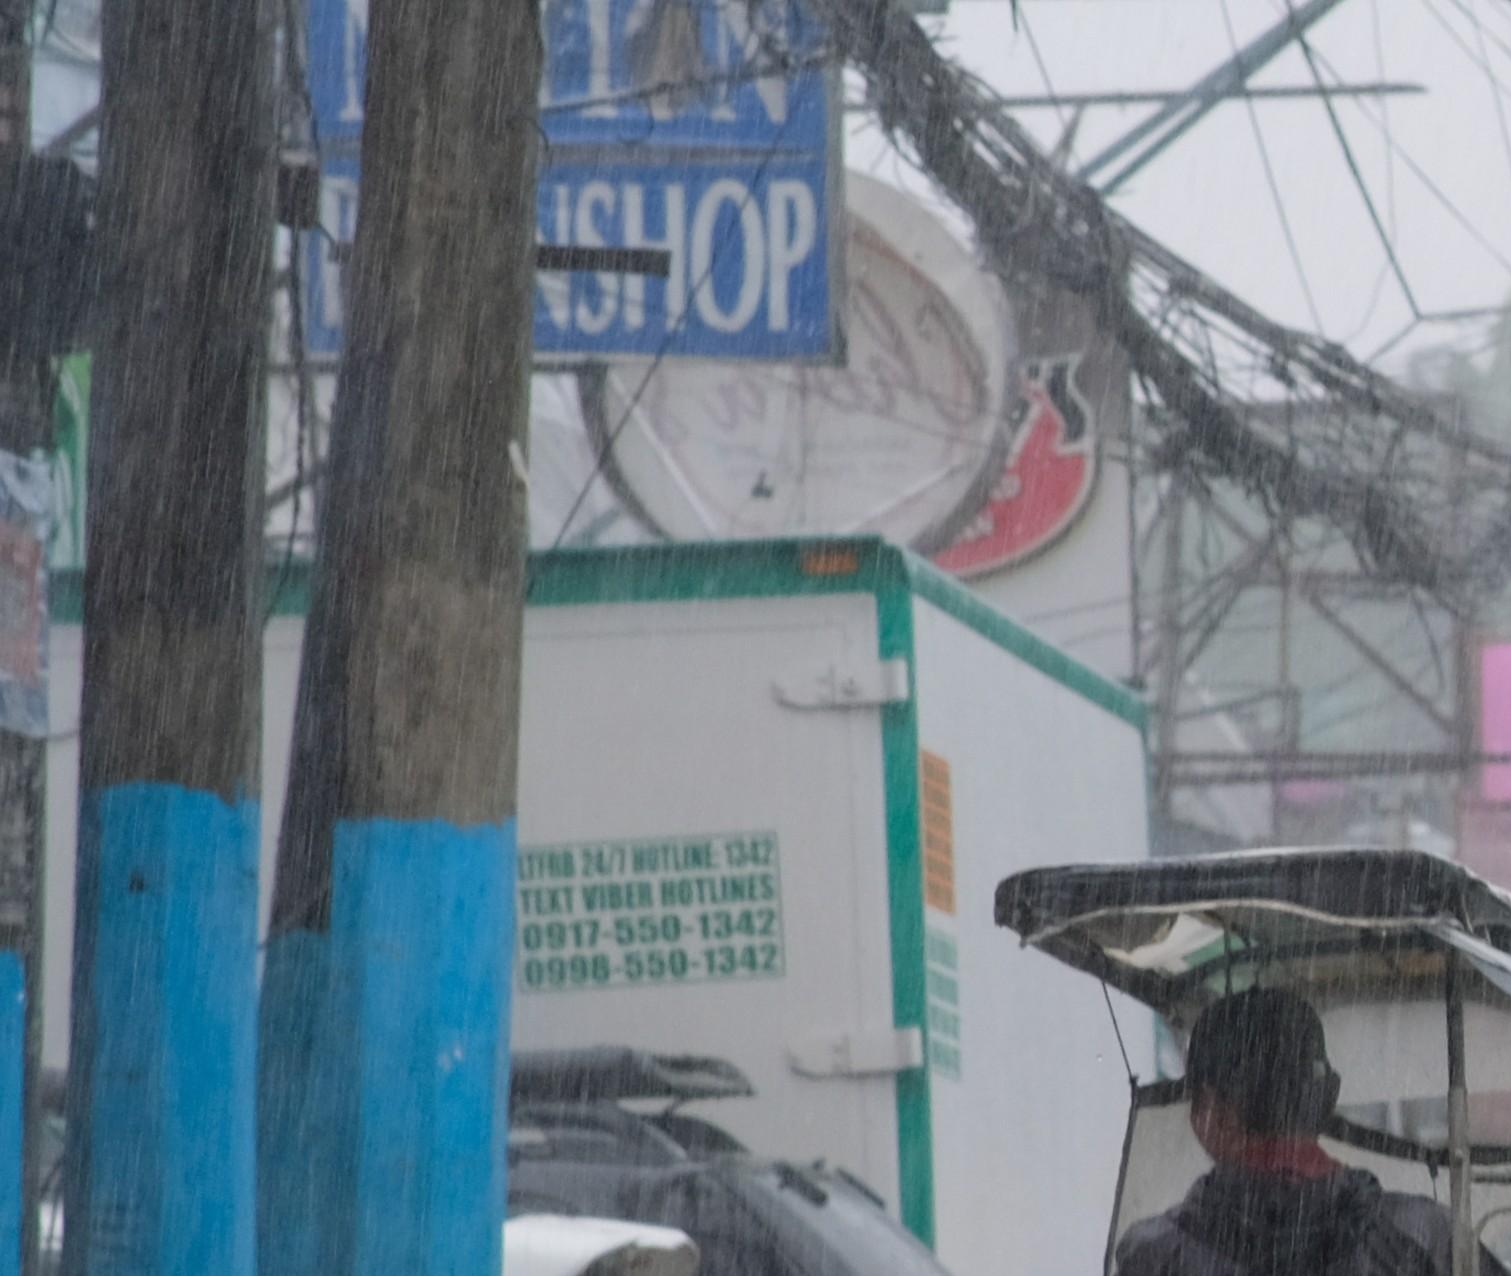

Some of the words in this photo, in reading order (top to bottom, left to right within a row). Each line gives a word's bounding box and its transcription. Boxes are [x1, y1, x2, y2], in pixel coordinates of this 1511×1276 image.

[320, 175, 817, 334] PNSHOP
[581, 847, 625, 876] 24/7
[632, 841, 715, 873] HOTLINE
[725, 838, 773, 867] 1342
[521, 886, 573, 915] TEXT
[581, 880, 654, 911] VIBER
[660, 873, 775, 907] HOTLINES
[523, 909, 776, 950] 0917-550-1342
[524, 944, 778, 986] 0998-550-1342
